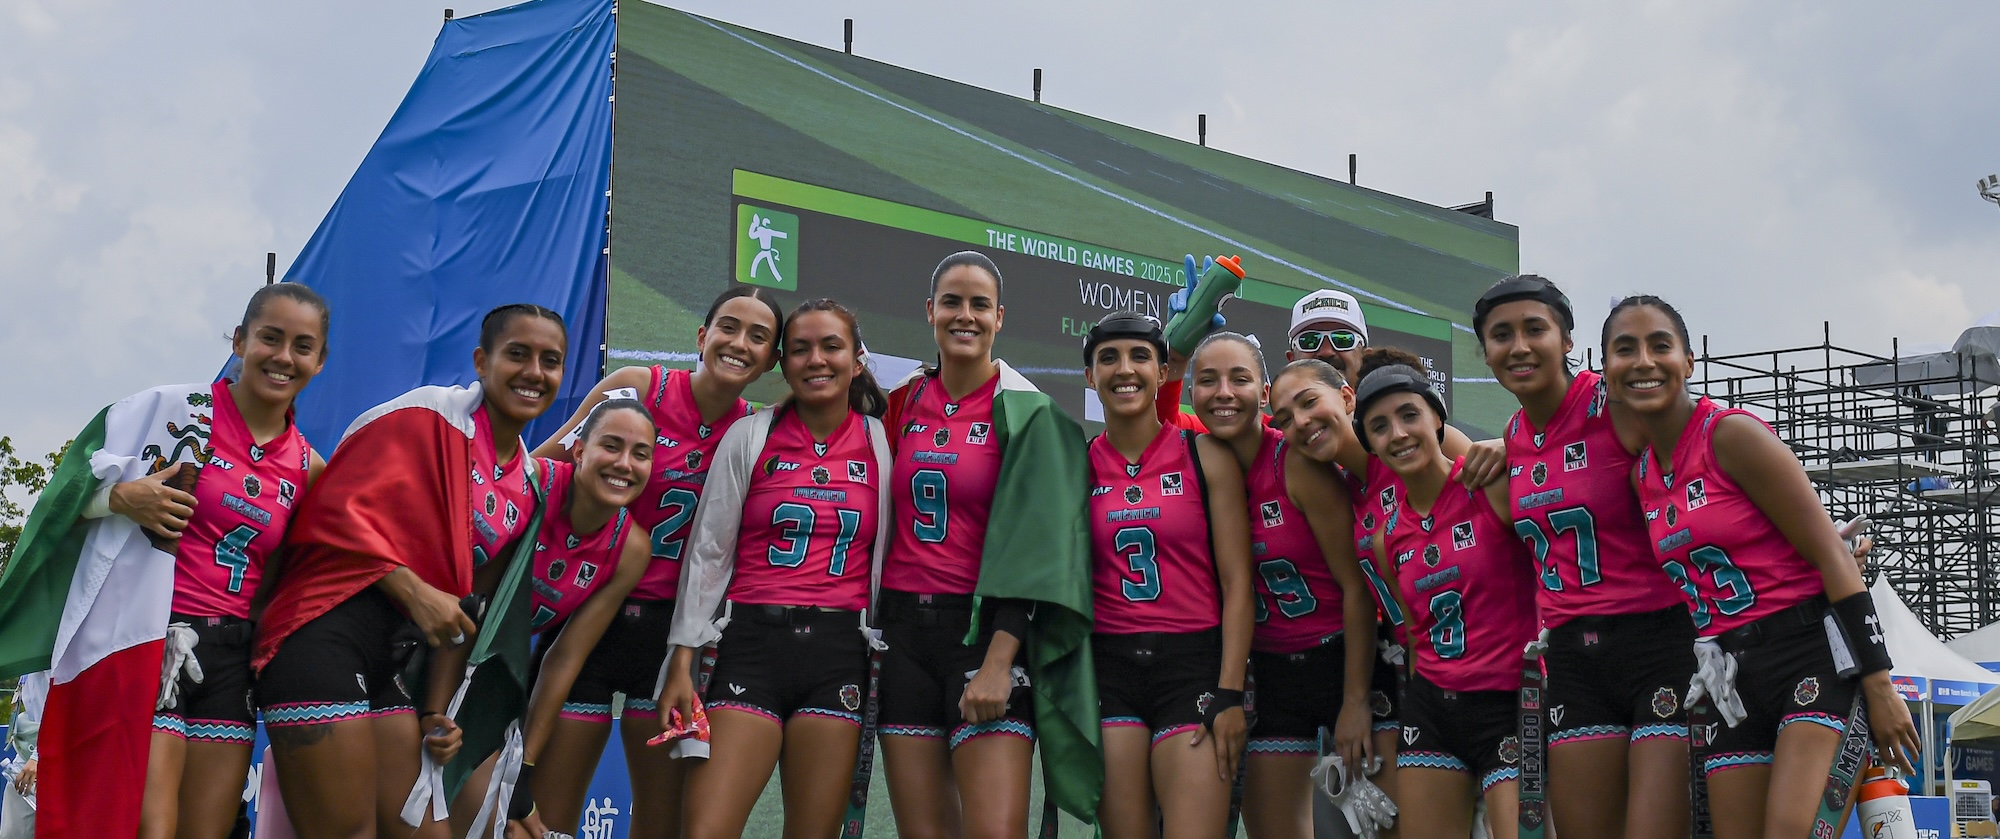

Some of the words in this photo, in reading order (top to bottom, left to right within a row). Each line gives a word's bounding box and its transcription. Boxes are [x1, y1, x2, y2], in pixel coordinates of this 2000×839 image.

[986, 229, 1016, 252] THE
[1021, 236, 1077, 265] WORLD
[1082, 250, 1134, 277] GAMES
[1140, 262, 1172, 284] 2025
[1079, 278, 1160, 319] WOMEN
[1427, 370, 1446, 382] ORLD
[209, 456, 234, 470] FAF
[776, 462, 800, 471] FAF
[651, 487, 700, 560] 2
[768, 502, 861, 577] 31
[911, 469, 948, 542] 9
[214, 523, 264, 593] 4
[1114, 526, 1163, 602] 3
[1514, 505, 1601, 592] 27
[1662, 545, 1756, 629] 33
[1429, 589, 1467, 659] 8
[1522, 714, 1541, 794] MEXICO
[1966, 756, 1994, 771] GAMES
[1815, 818, 1835, 839] 33
